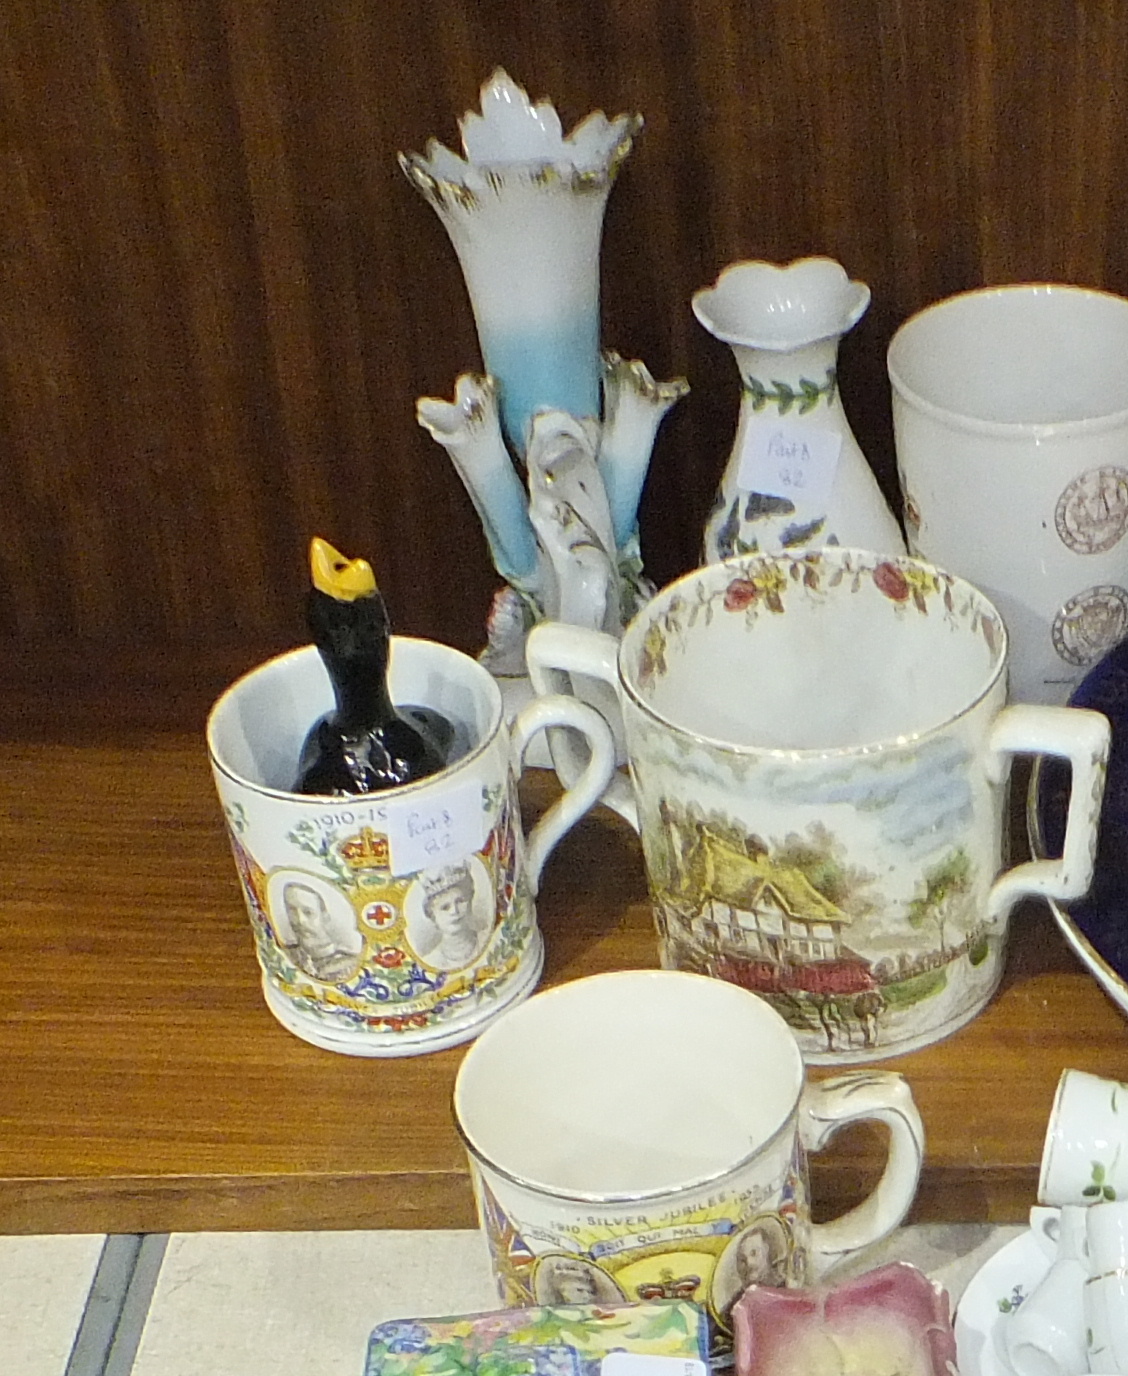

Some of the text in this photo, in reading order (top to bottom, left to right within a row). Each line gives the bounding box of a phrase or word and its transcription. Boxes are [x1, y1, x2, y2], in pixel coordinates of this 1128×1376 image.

[586, 1214, 648, 1228] SILVER
[659, 1191, 728, 1223] JUBILEE
[672, 1226, 700, 1239] MAL
